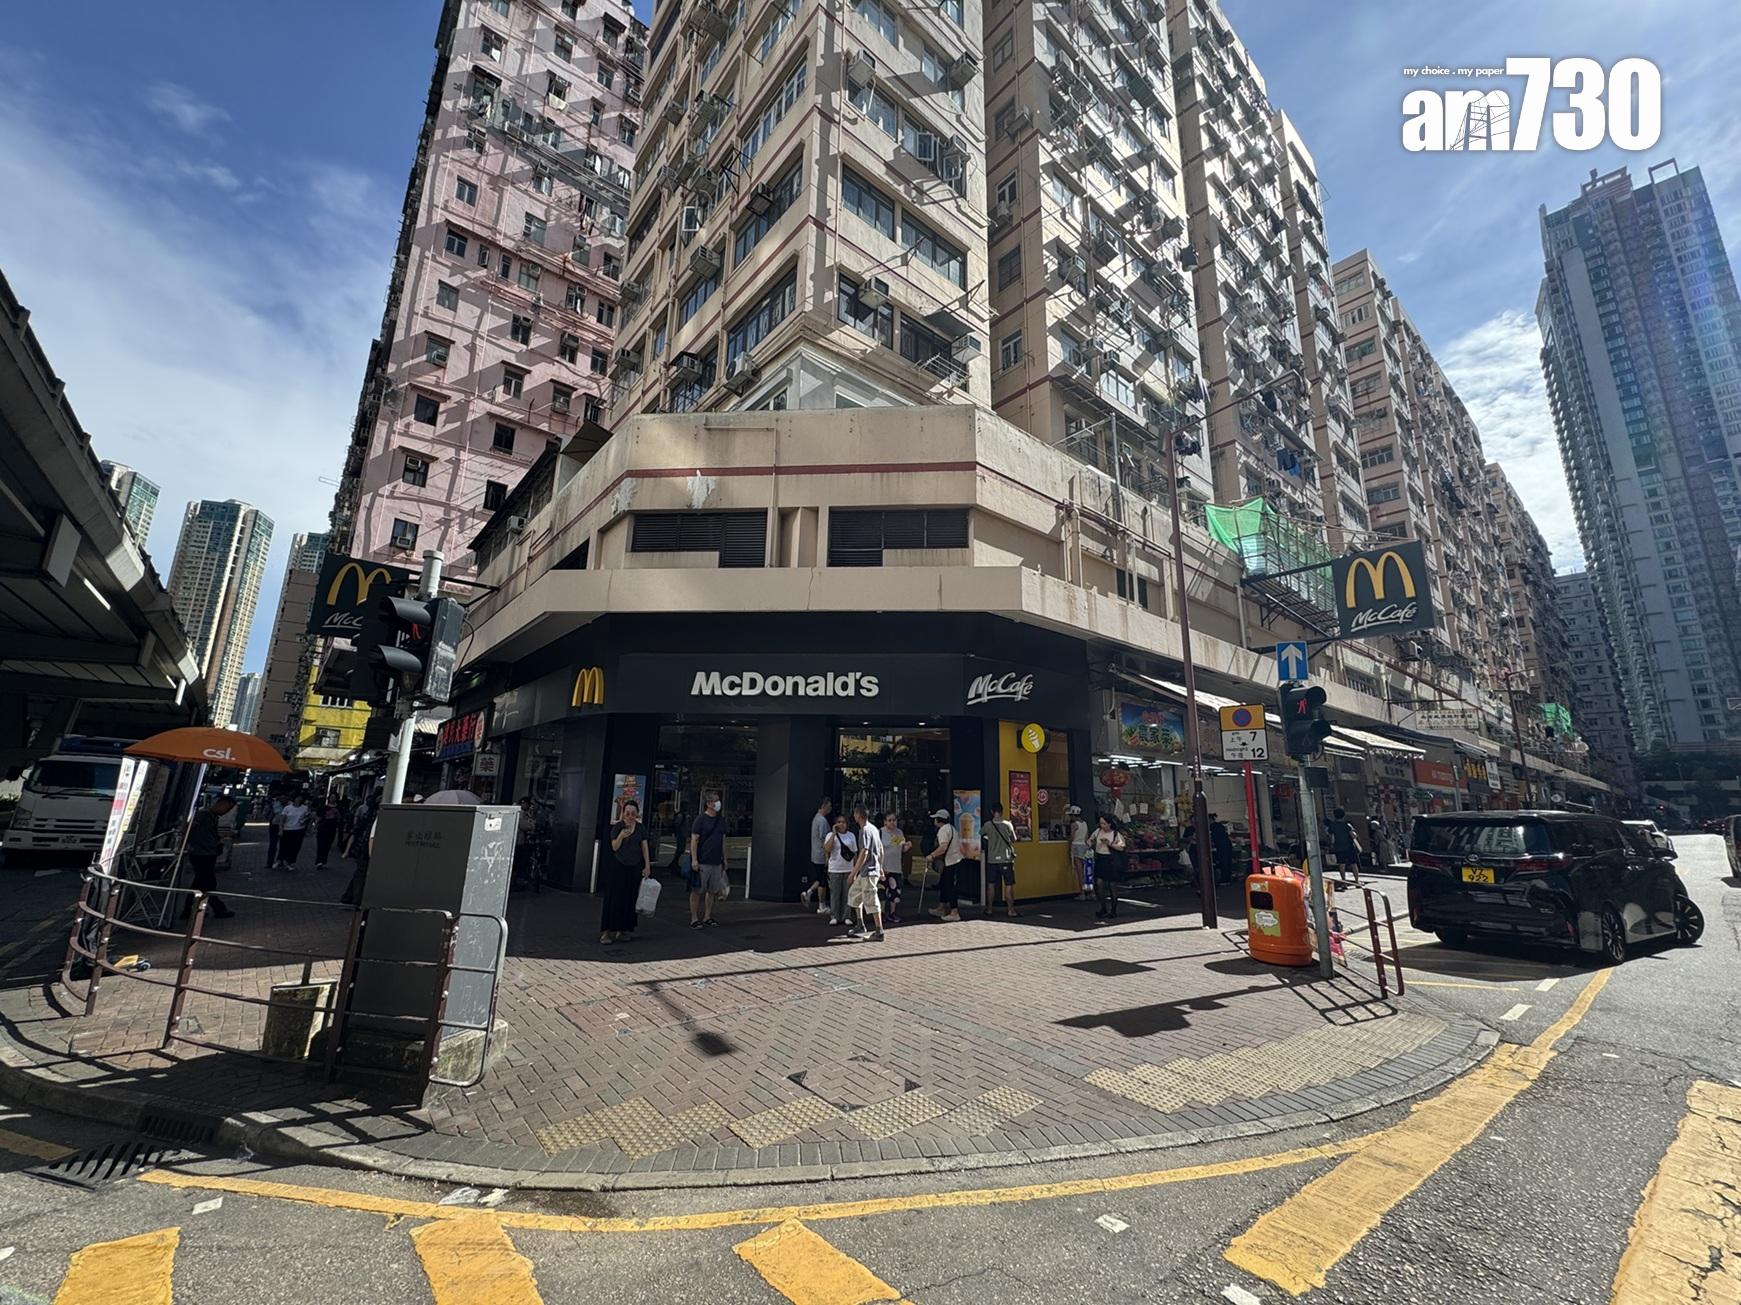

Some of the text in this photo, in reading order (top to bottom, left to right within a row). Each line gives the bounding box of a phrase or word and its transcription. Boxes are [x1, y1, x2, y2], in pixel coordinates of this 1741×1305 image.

[1350, 602, 1417, 632] McCafé
[690, 671, 880, 697] McDonald's
[966, 672, 1034, 705] McCafé
[1249, 731, 1257, 742] 7
[203, 748, 236, 761] csl.
[1251, 747, 1265, 758] 12
[479, 757, 495, 772] 藥
